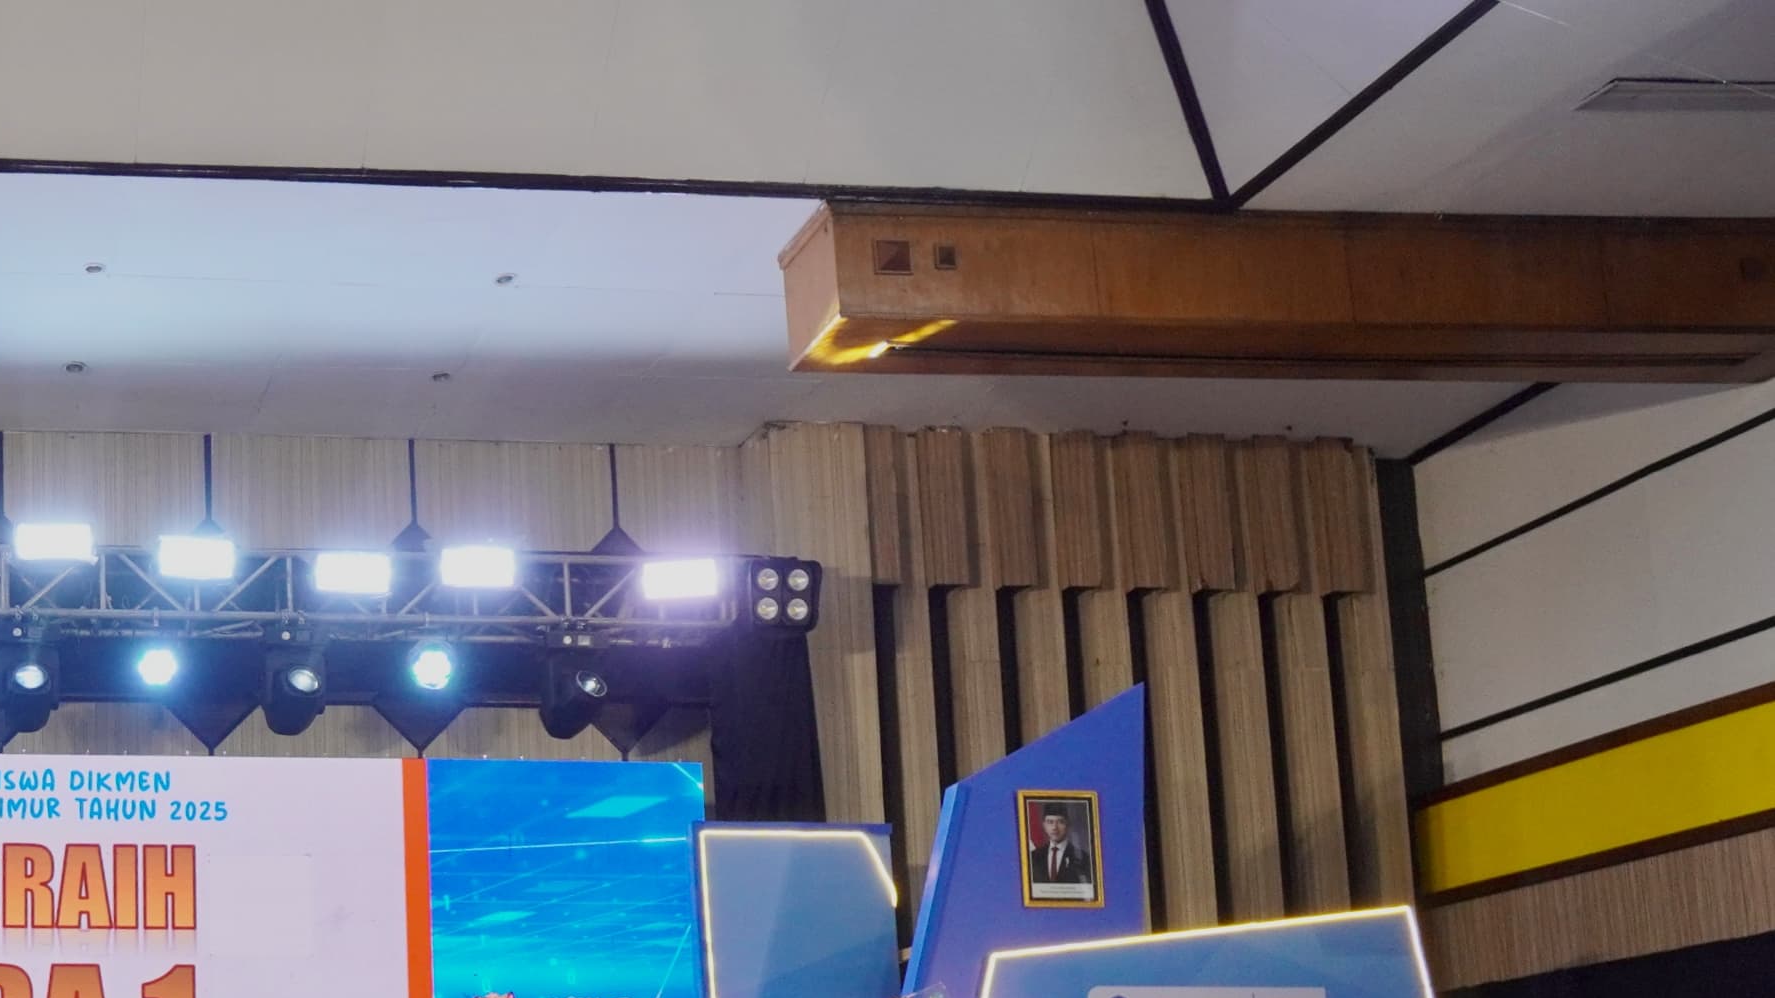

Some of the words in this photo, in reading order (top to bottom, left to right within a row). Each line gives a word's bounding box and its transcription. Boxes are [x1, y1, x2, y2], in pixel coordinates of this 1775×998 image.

[69, 770, 172, 793] DIKMEN
[76, 797, 157, 821] TAHUN
[169, 800, 229, 823] 2025
